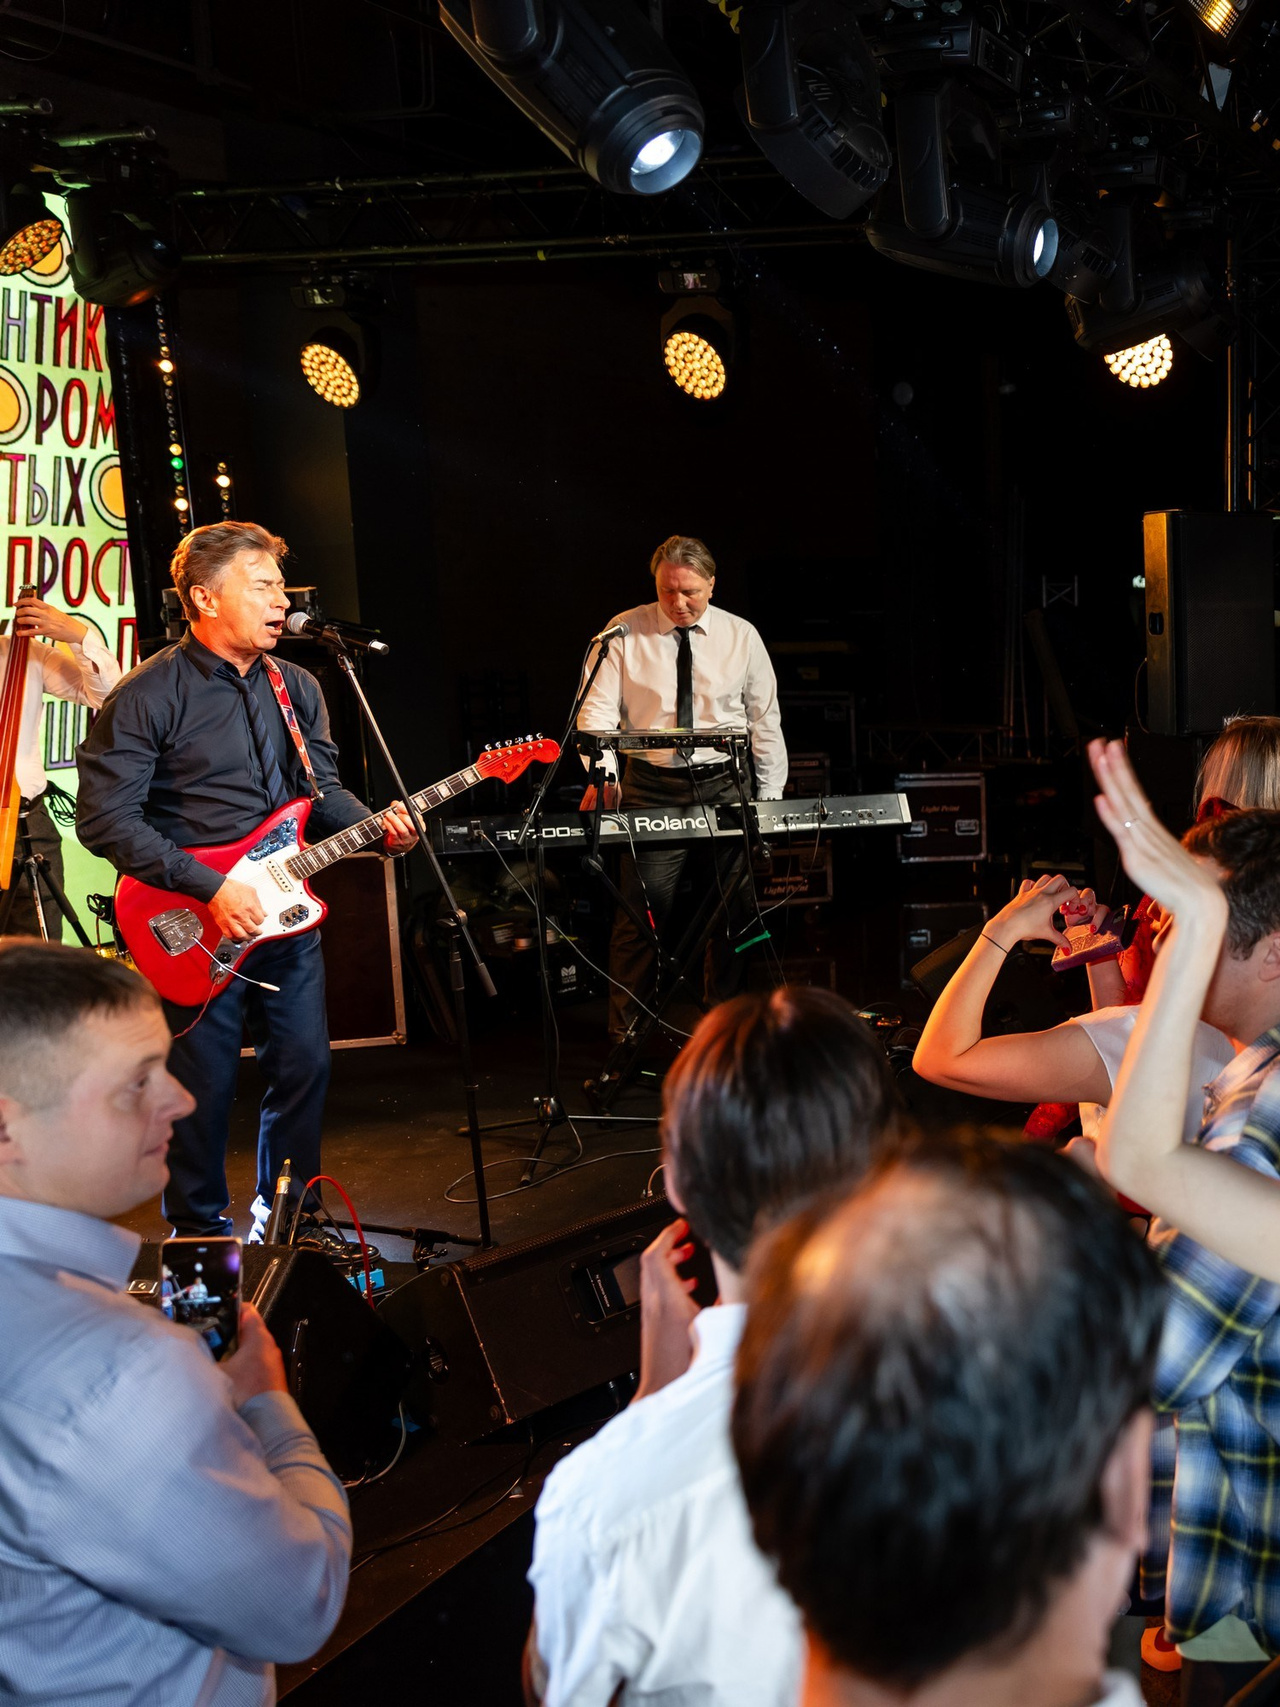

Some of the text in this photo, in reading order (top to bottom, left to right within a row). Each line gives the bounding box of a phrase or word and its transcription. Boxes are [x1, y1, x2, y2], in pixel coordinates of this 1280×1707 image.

[1, 287, 109, 372] НТИК
[0, 452, 86, 526] ТЫХ
[634, 813, 709, 833] Roland
